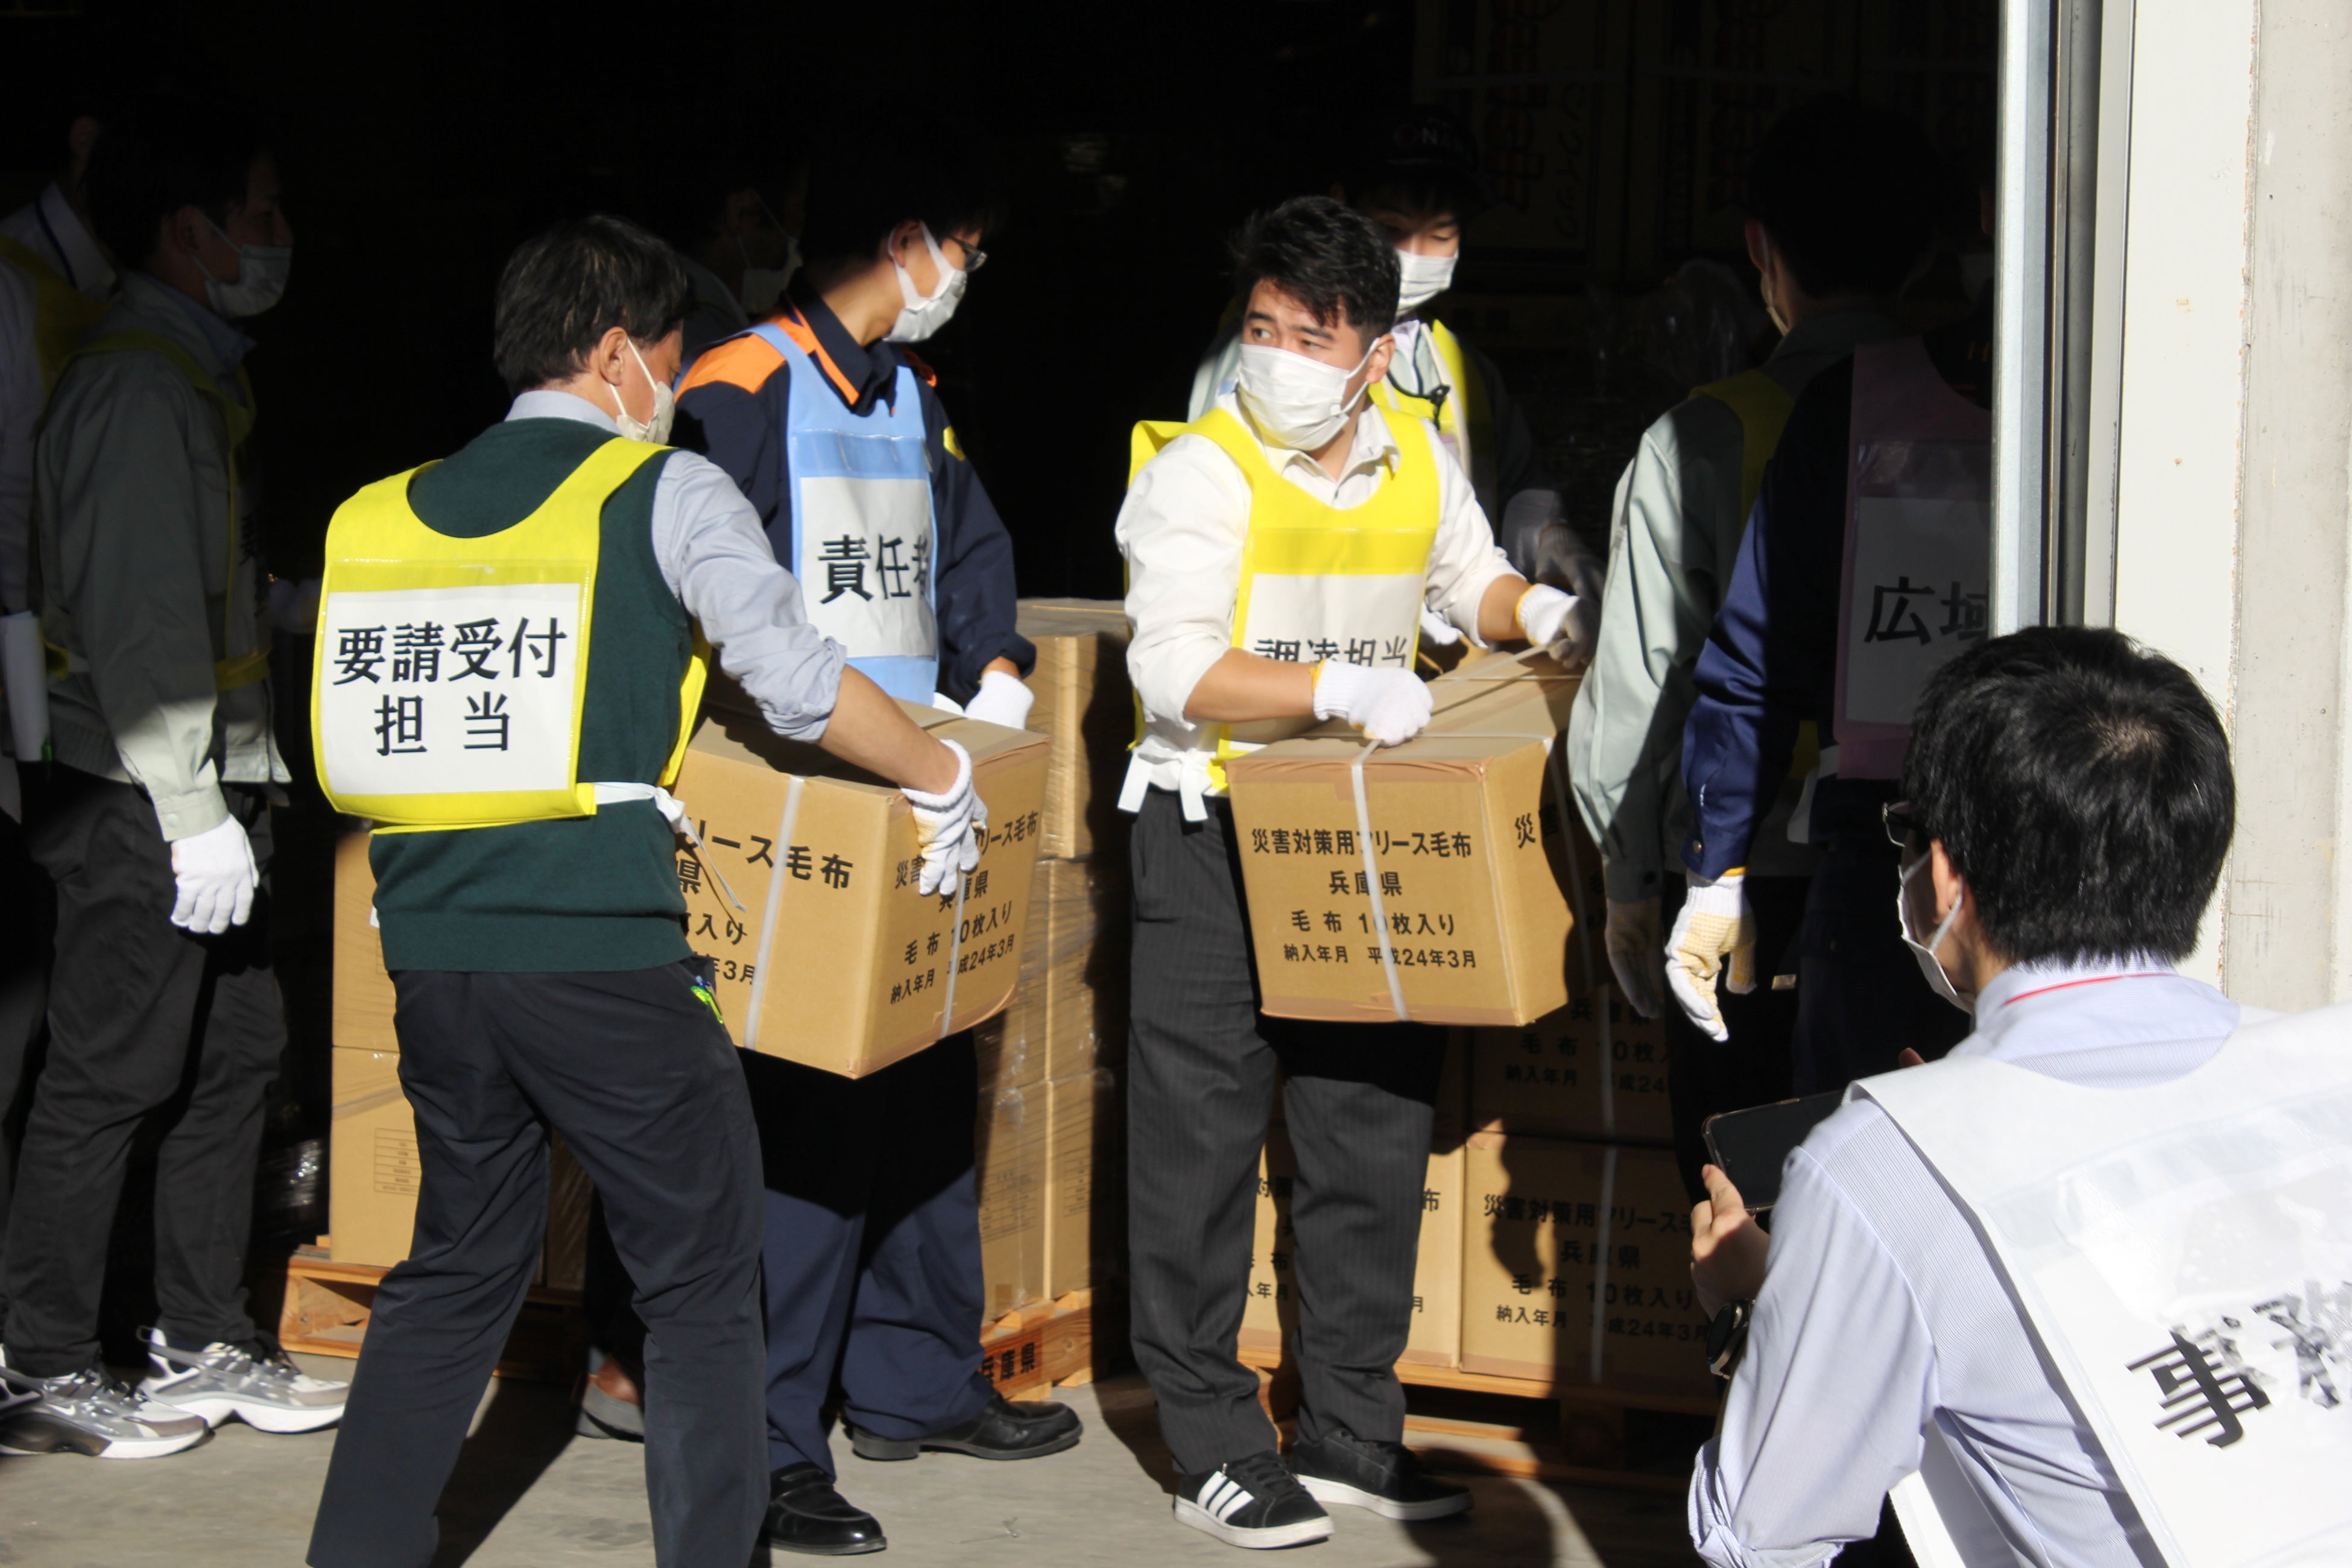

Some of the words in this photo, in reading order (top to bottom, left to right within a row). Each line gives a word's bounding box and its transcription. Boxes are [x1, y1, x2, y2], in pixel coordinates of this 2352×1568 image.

[333, 616, 567, 685] 要請受付
[373, 691, 510, 756] 担当
